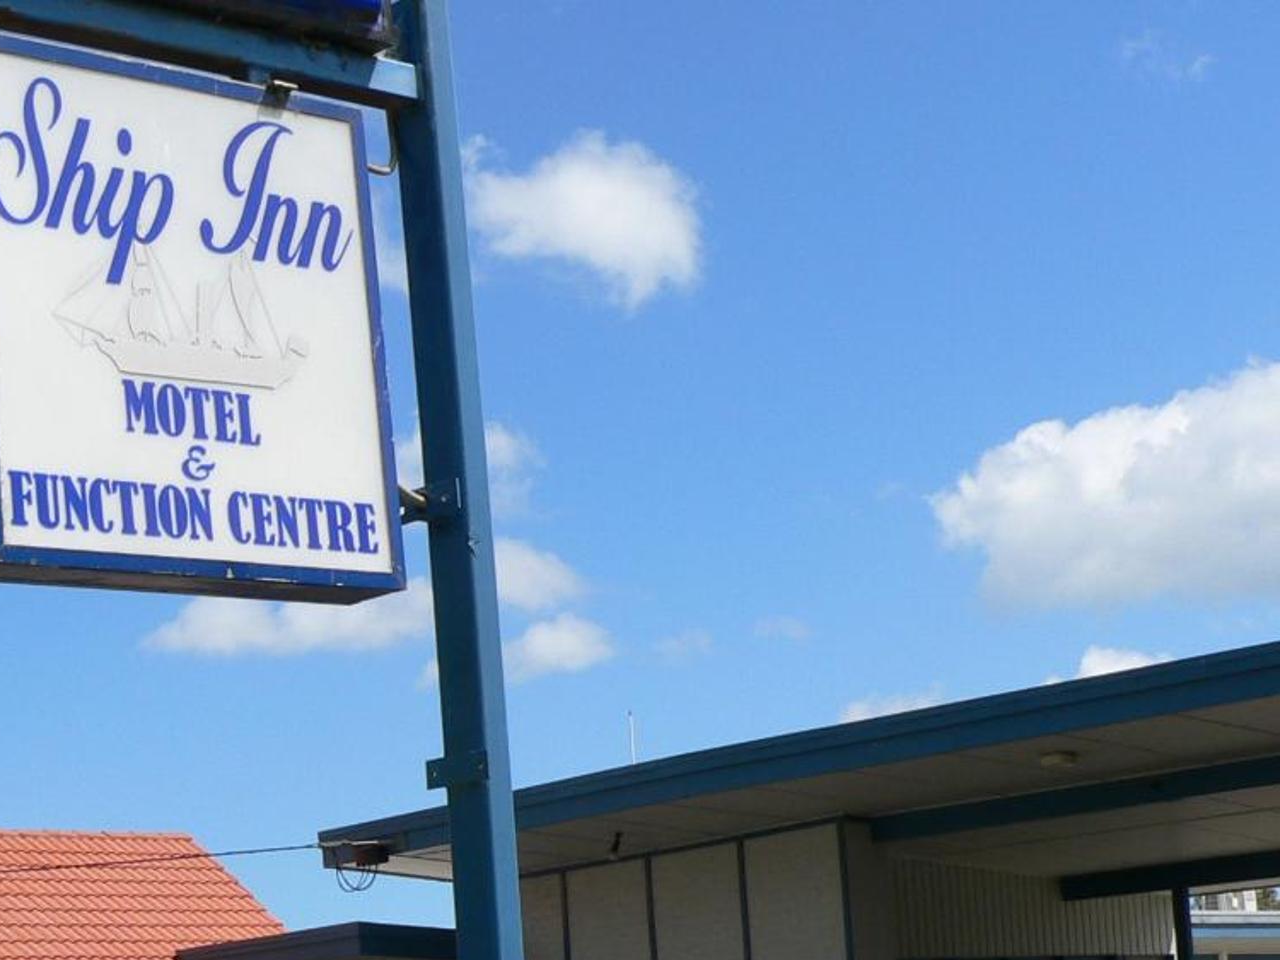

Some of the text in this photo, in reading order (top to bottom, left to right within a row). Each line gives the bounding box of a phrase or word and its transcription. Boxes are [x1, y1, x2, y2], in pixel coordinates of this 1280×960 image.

[200, 121, 352, 272] Inn
[122, 378, 261, 447] MOTEL
[182, 444, 216, 482] &
[8, 468, 380, 555] FUNCTION CENTRE
